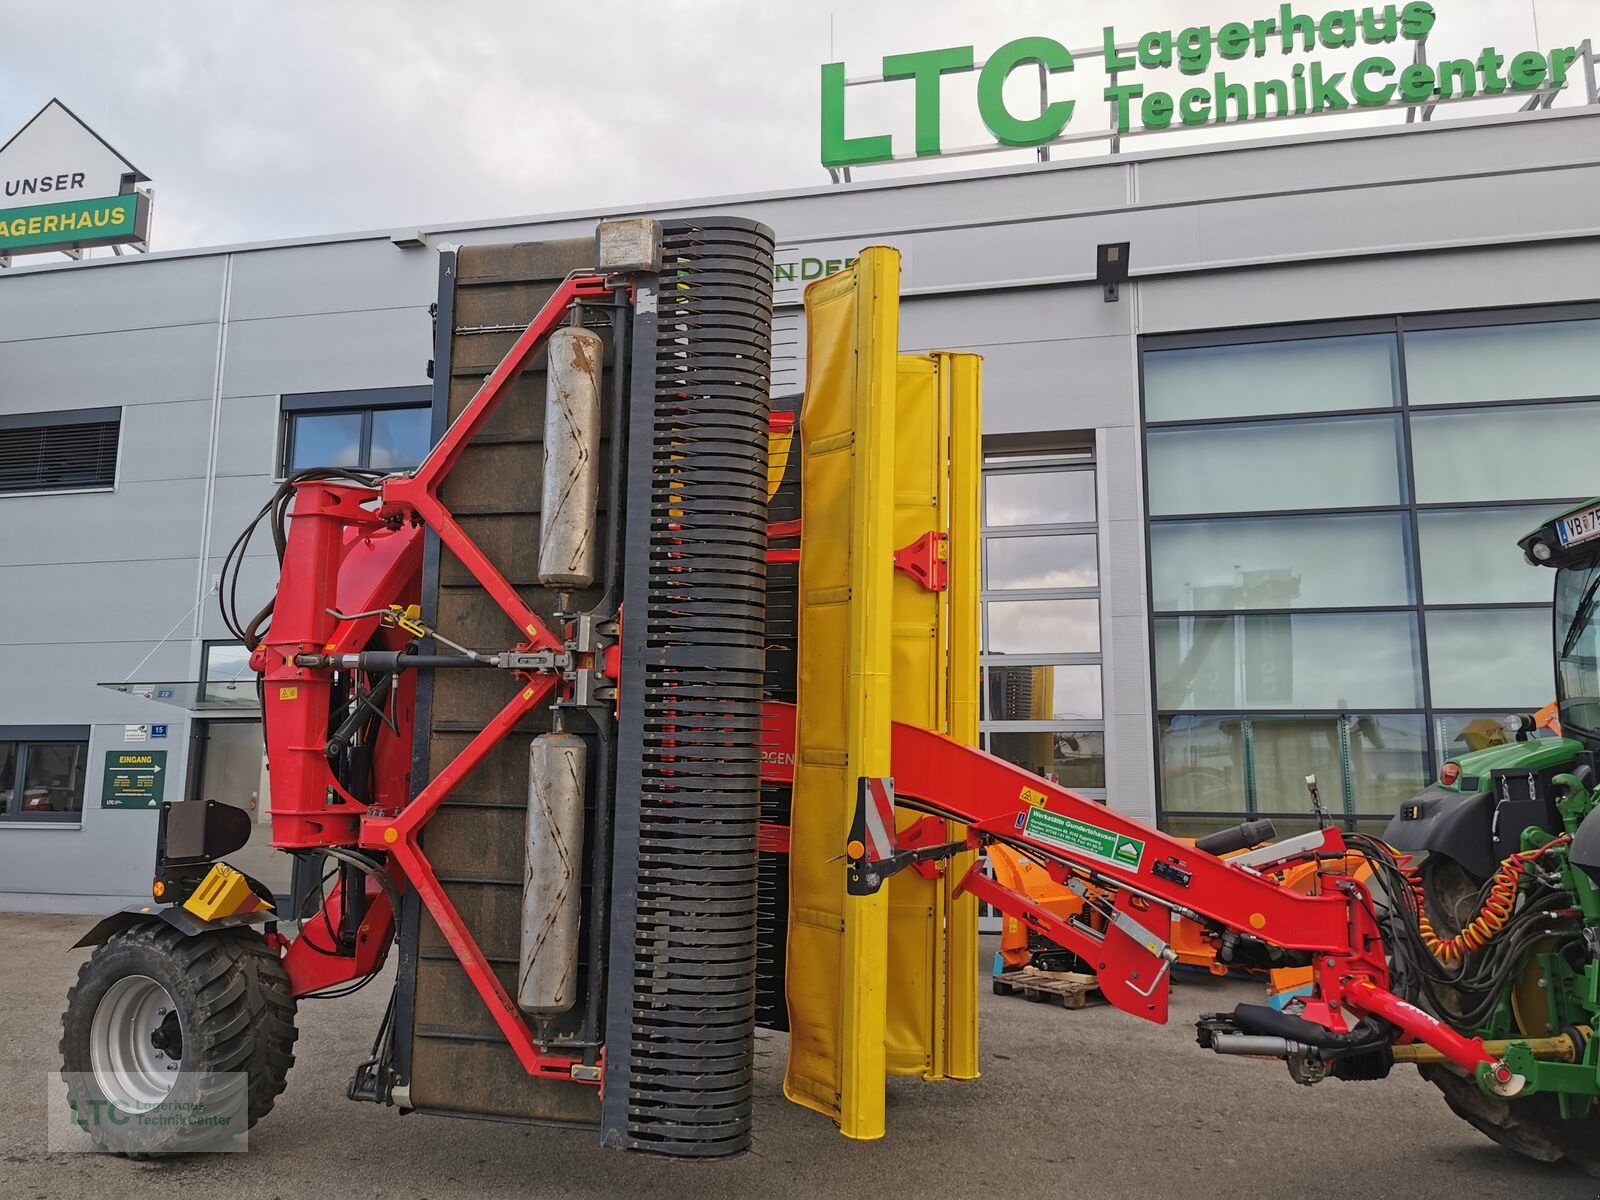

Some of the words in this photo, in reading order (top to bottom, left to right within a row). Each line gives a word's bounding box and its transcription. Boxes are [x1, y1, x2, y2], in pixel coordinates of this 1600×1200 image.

[1103, 1, 1435, 76] Lagerhaus
[821, 36, 1076, 168] LTC
[1104, 46, 1576, 134] TechnikCenter
[5, 172, 86, 197] UNSER
[1566, 517, 1583, 537] VB
[155, 726, 164, 734] 15
[119, 756, 152, 764] EINGANG
[1033, 809, 1065, 826] Werkstätte
[1065, 821, 1117, 842] Gundertshausen
